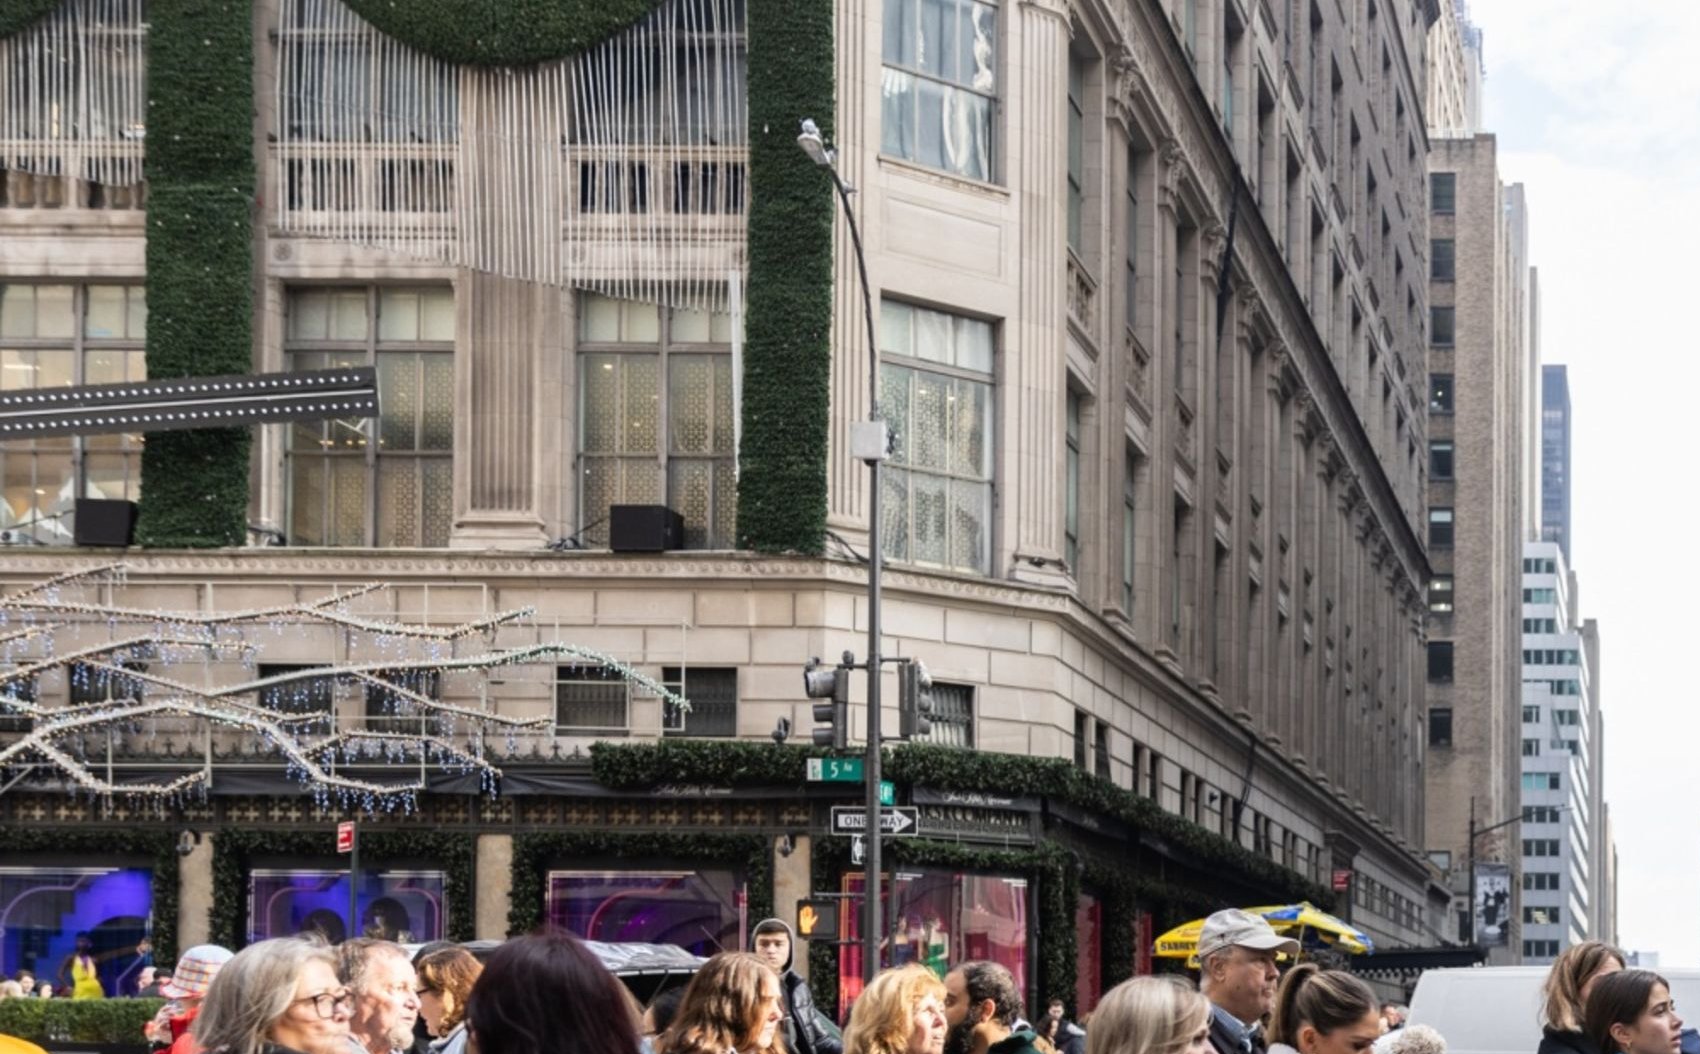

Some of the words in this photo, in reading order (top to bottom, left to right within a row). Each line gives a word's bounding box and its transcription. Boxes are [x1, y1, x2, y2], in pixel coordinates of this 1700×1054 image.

[830, 761, 839, 778] 5
[844, 816, 867, 826] ONE
[880, 817, 904, 827] WAY
